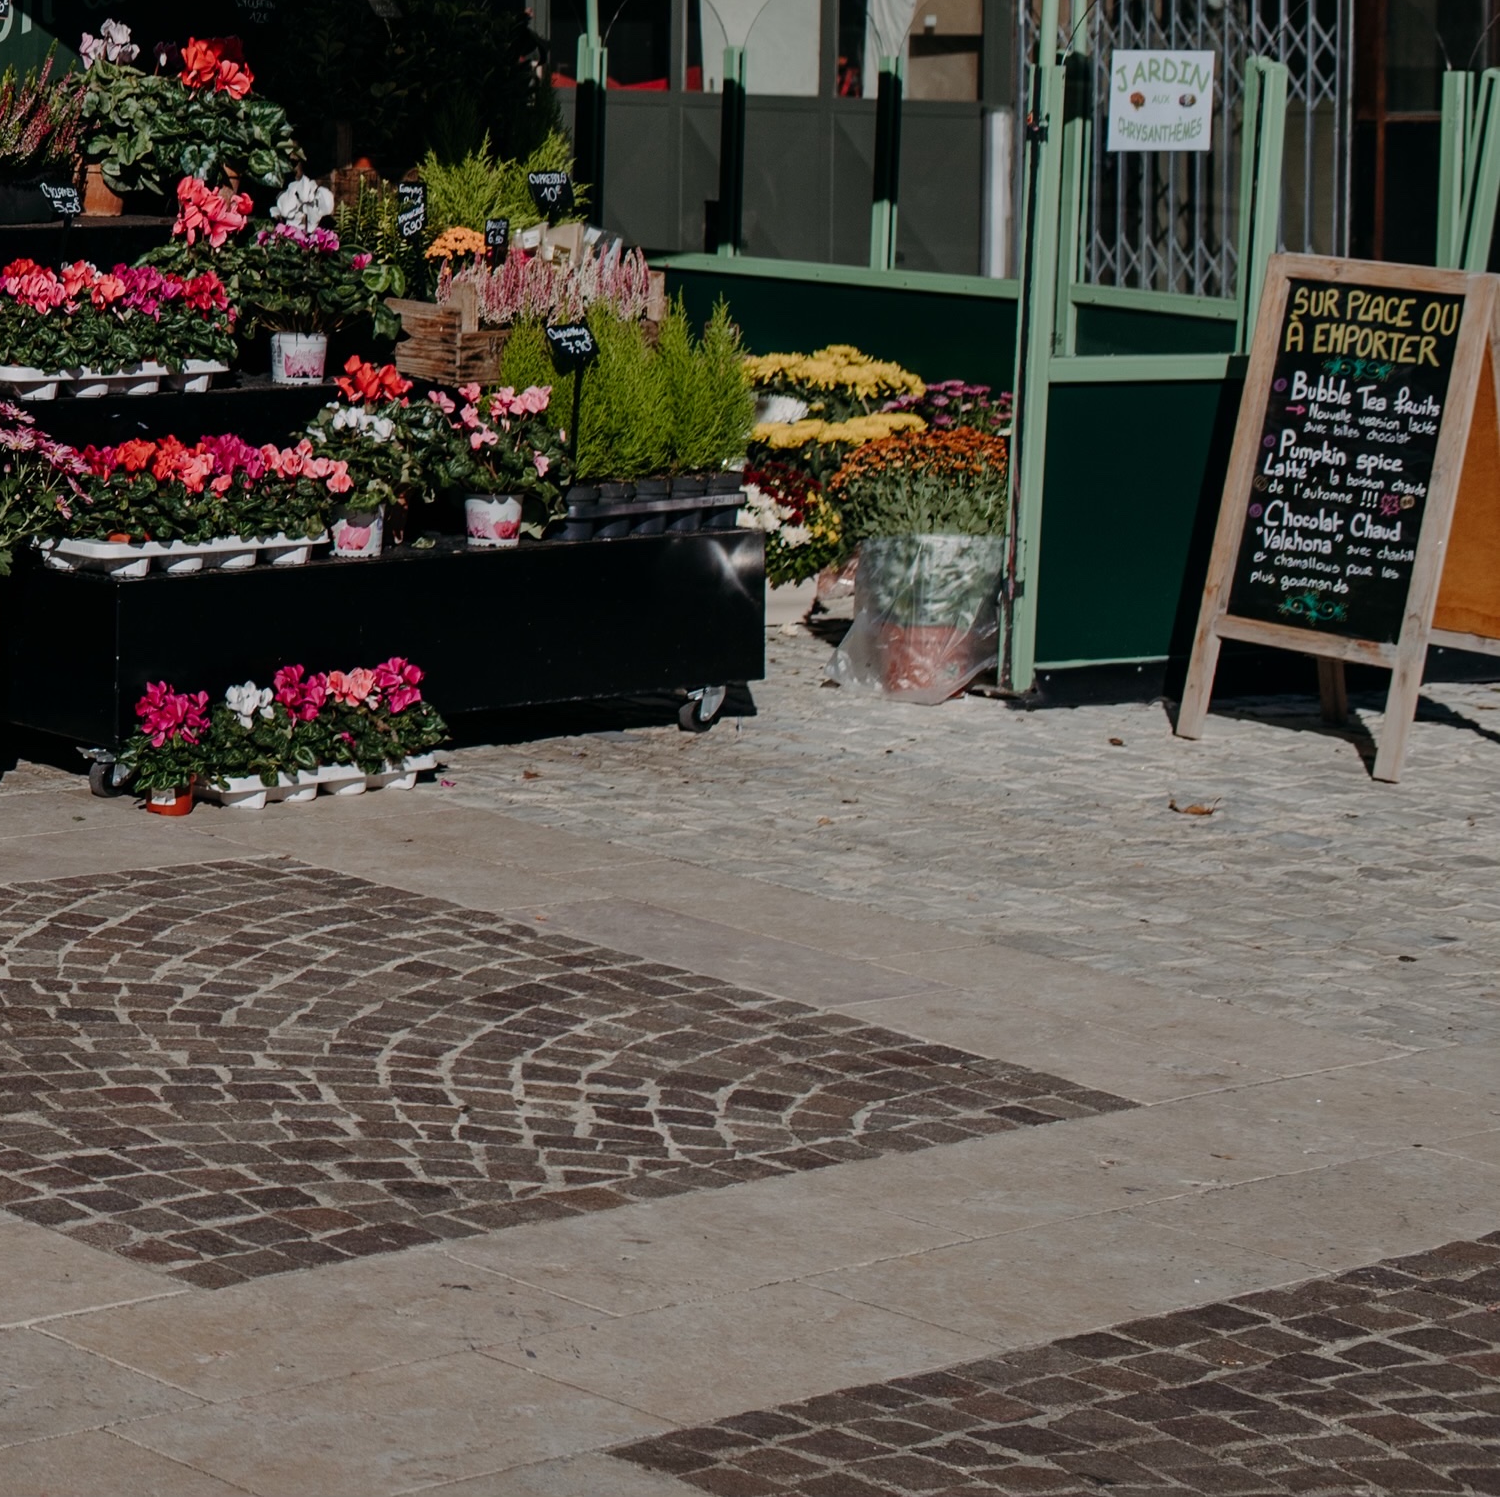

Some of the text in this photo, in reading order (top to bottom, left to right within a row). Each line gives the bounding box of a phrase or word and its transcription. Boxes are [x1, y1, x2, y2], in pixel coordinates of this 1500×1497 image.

[1115, 57, 1210, 94] JARDIN
[1152, 94, 1171, 105] AUX
[1118, 116, 1203, 143] CHRYSANTHÈMES
[1294, 287, 1459, 336] SUR PLACE OU
[1285, 311, 1304, 353] À
[1291, 370, 1441, 417] Bubble Tea fruits
[1303, 421, 1412, 444] avec billes chocolat
[1308, 402, 1438, 435] Nouvelle version lactée
[1279, 429, 1404, 477] Pumpkin spice
[1267, 478, 1284, 494] de
[1329, 468, 1340, 486] la
[1346, 472, 1385, 491] boisson
[1390, 479, 1427, 497] chaude
[1264, 500, 1402, 542] Chocolat Chaud
[1253, 551, 1400, 579] et chamallows pour les
[1346, 544, 1372, 557] avec
[1250, 569, 1350, 594] plus gourmands
